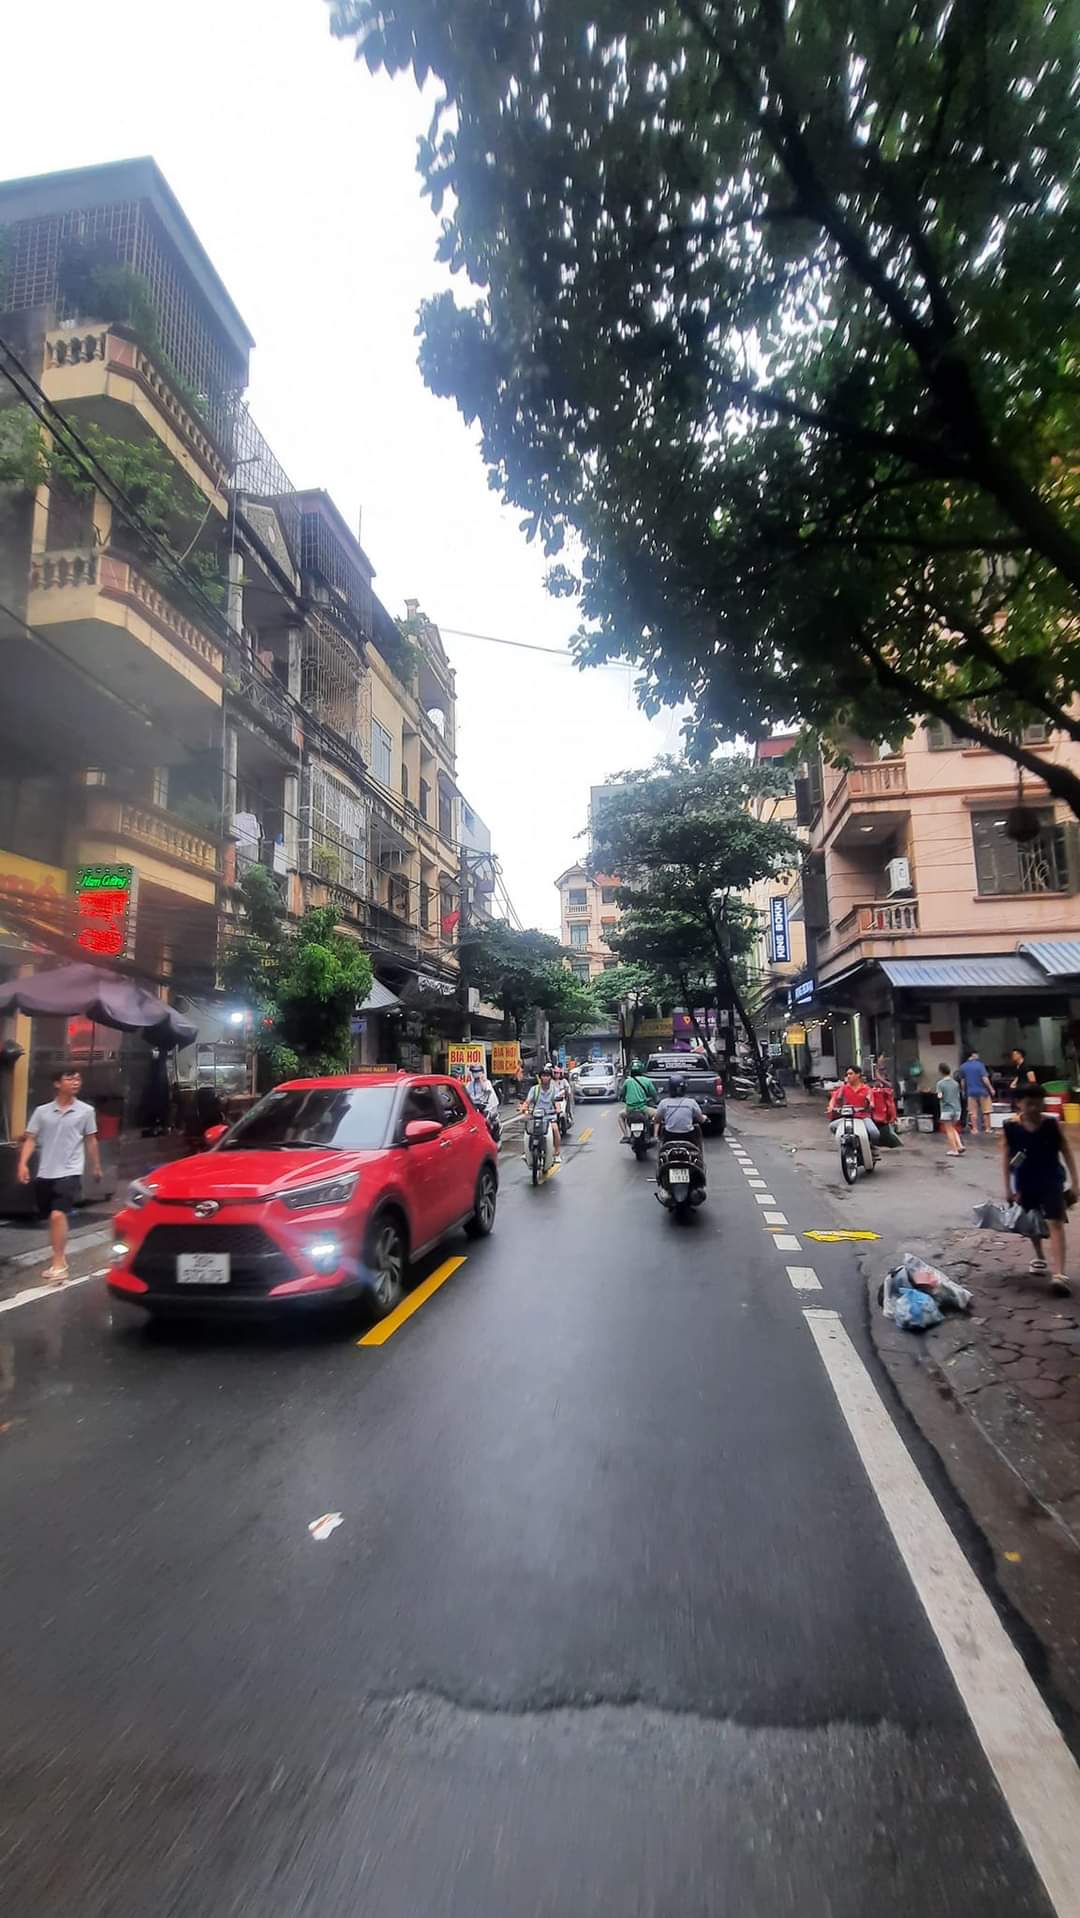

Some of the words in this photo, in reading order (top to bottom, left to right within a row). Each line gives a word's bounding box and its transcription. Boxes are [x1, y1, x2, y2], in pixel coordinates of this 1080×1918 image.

[774, 901, 784, 931] BOKKI
[776, 934, 786, 958] KING
[450, 1050, 465, 1063] BIA
